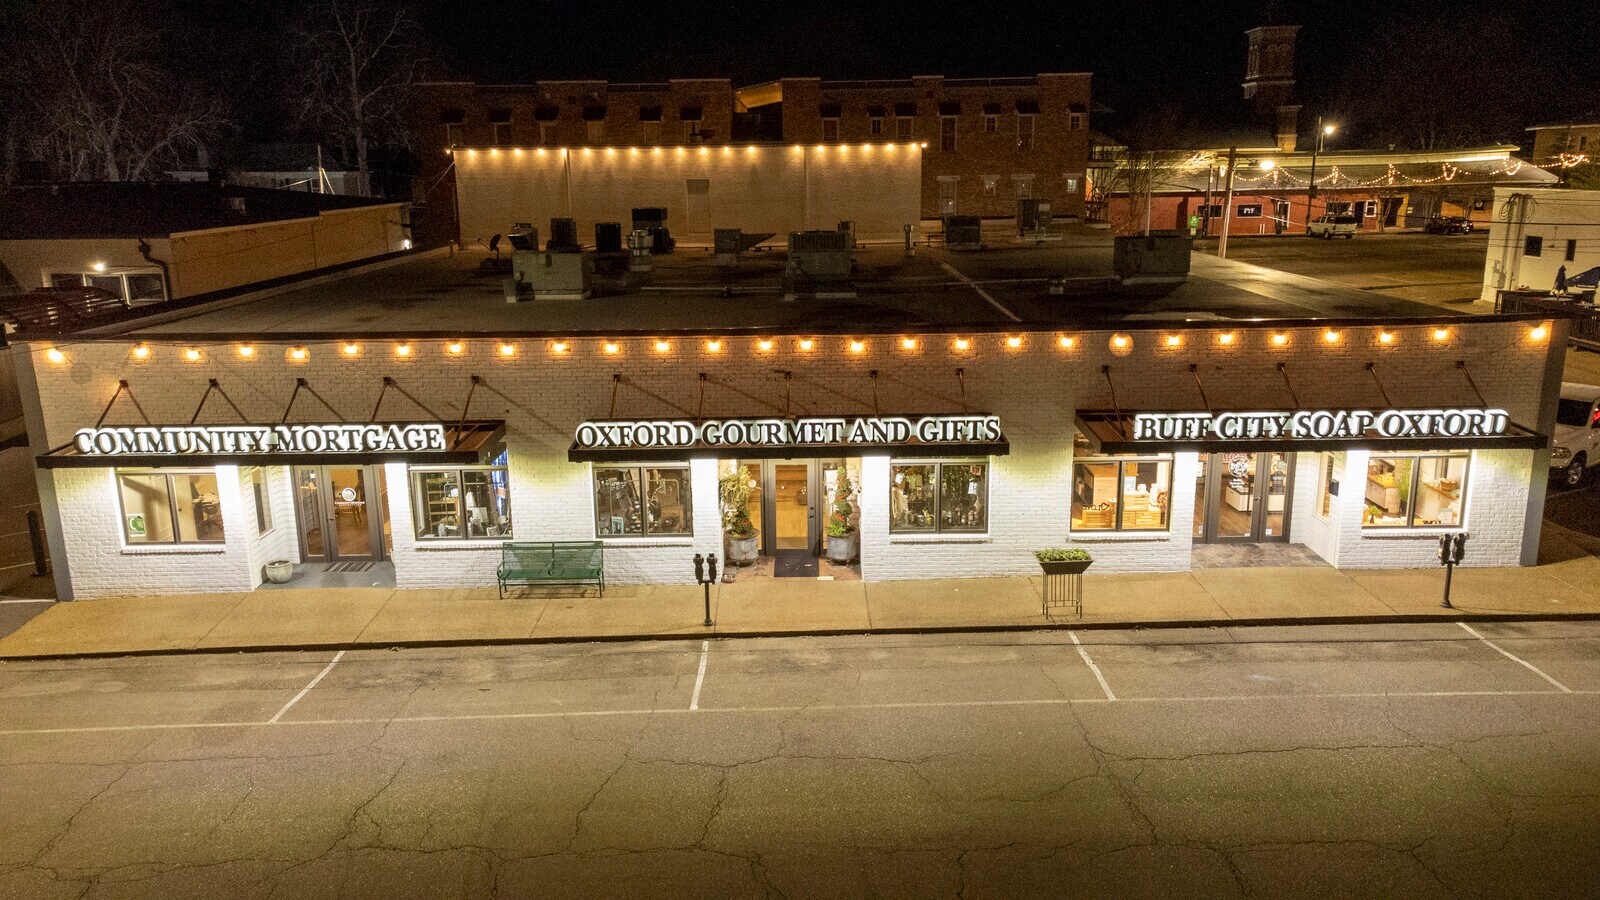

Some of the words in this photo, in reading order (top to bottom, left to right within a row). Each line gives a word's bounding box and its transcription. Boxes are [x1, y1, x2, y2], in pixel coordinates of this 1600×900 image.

[73, 428, 269, 454] COMMUNITY
[276, 426, 443, 452] MORTGAGE
[576, 423, 696, 448] OXFORD
[701, 421, 845, 446] GOURMET
[849, 419, 912, 444] AND
[917, 417, 1000, 442] GIFTS
[1136, 415, 1213, 440] BUFF
[1218, 415, 1290, 440] CITY
[1296, 413, 1375, 438] SOAP
[1381, 412, 1511, 437] OXFORD
